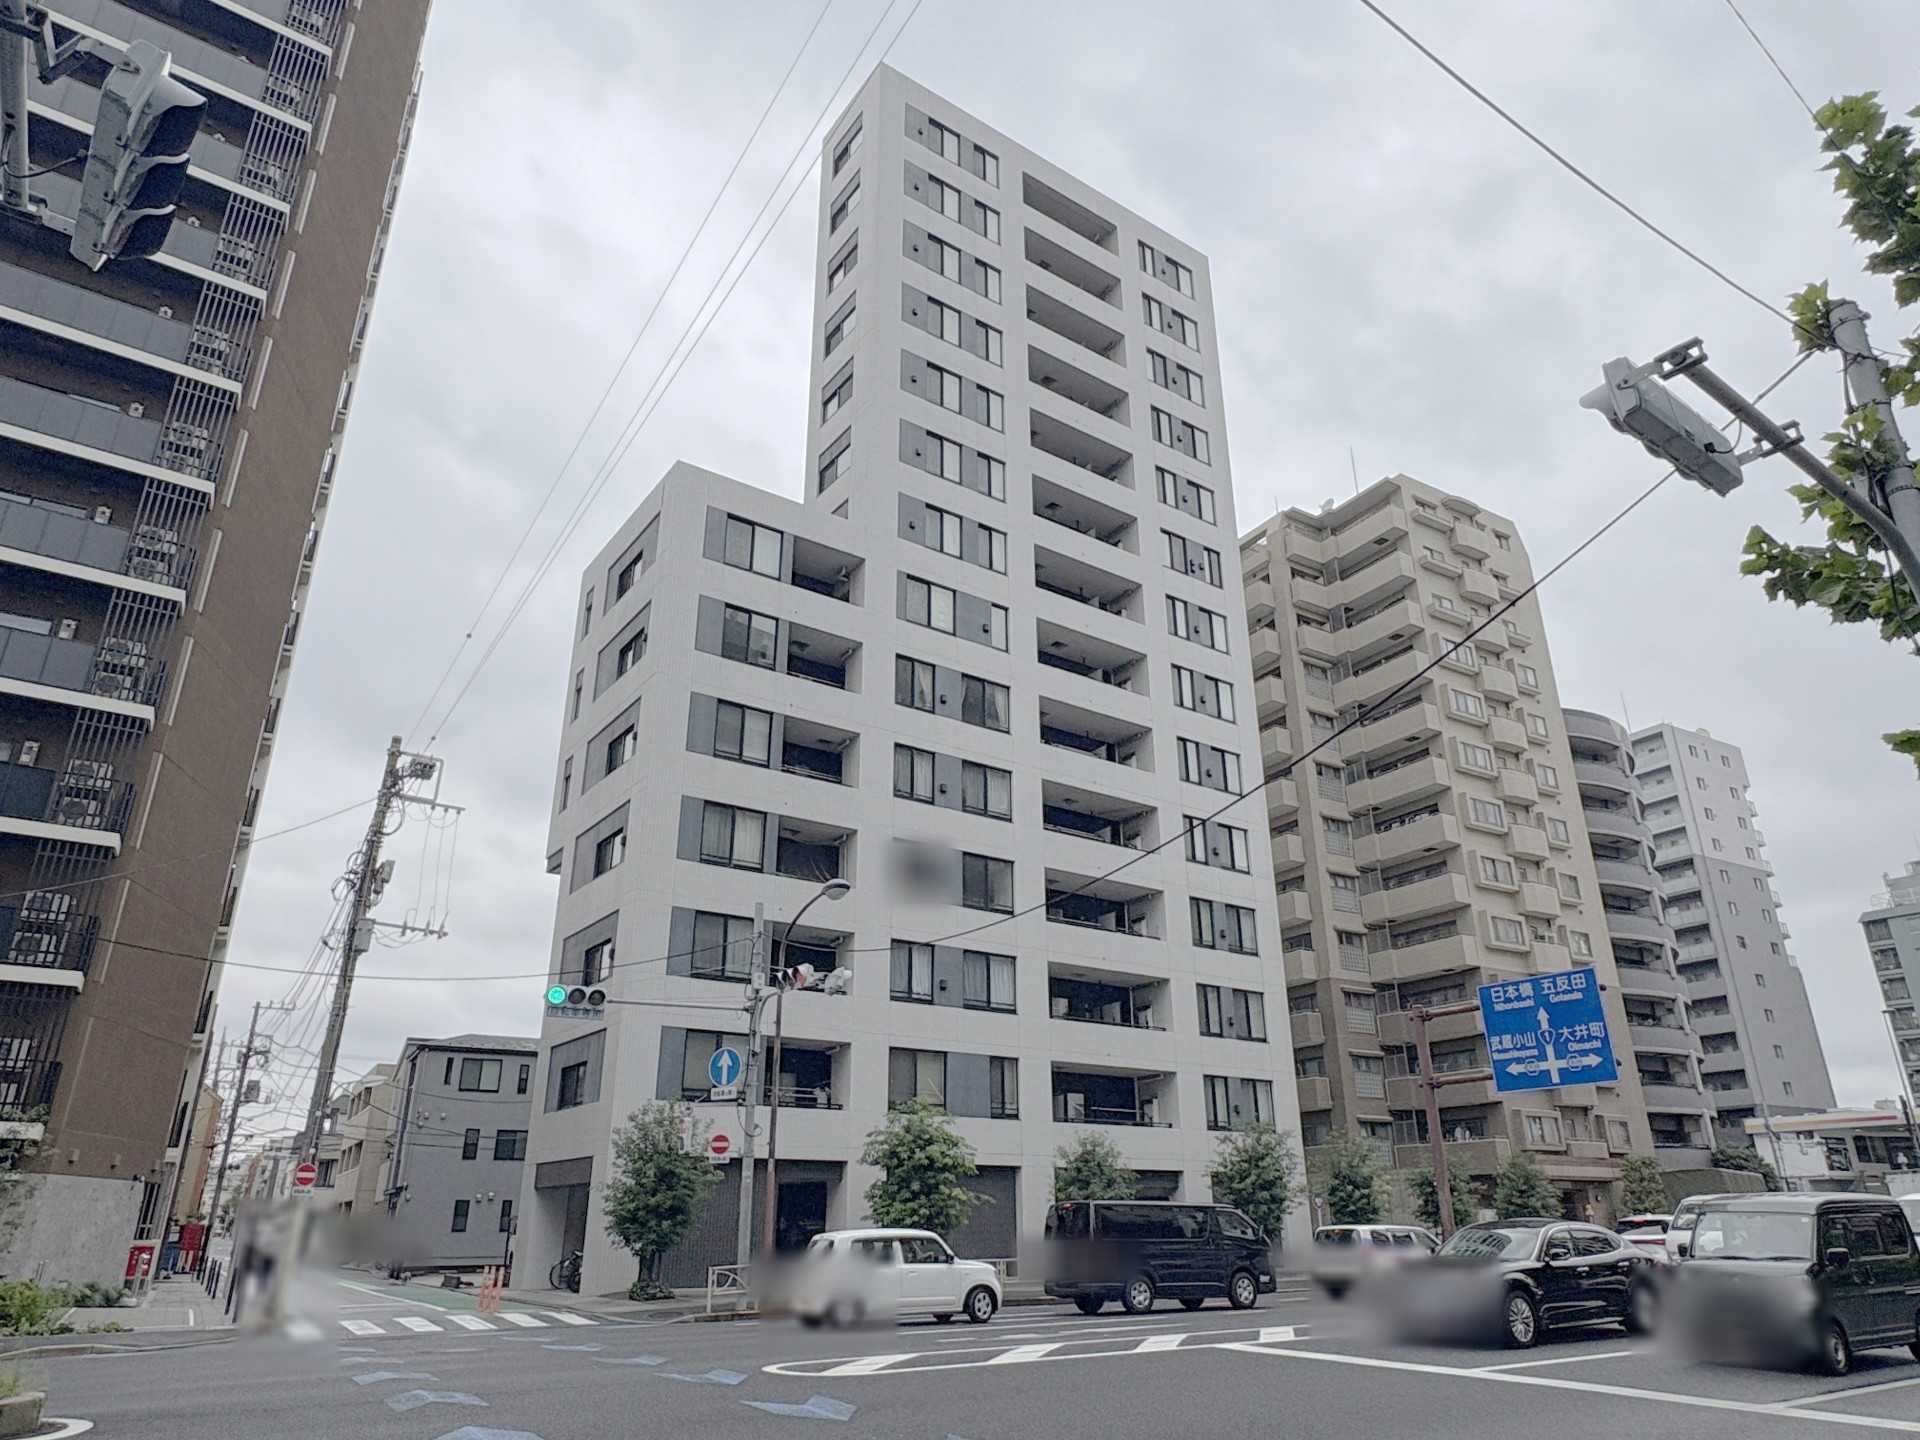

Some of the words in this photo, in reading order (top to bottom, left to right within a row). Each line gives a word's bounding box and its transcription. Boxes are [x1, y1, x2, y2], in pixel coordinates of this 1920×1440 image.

[1490, 982, 1534, 1002] 日本橋
[1541, 973, 1586, 995] 五反田
[1558, 1022, 1605, 1042] 大井町
